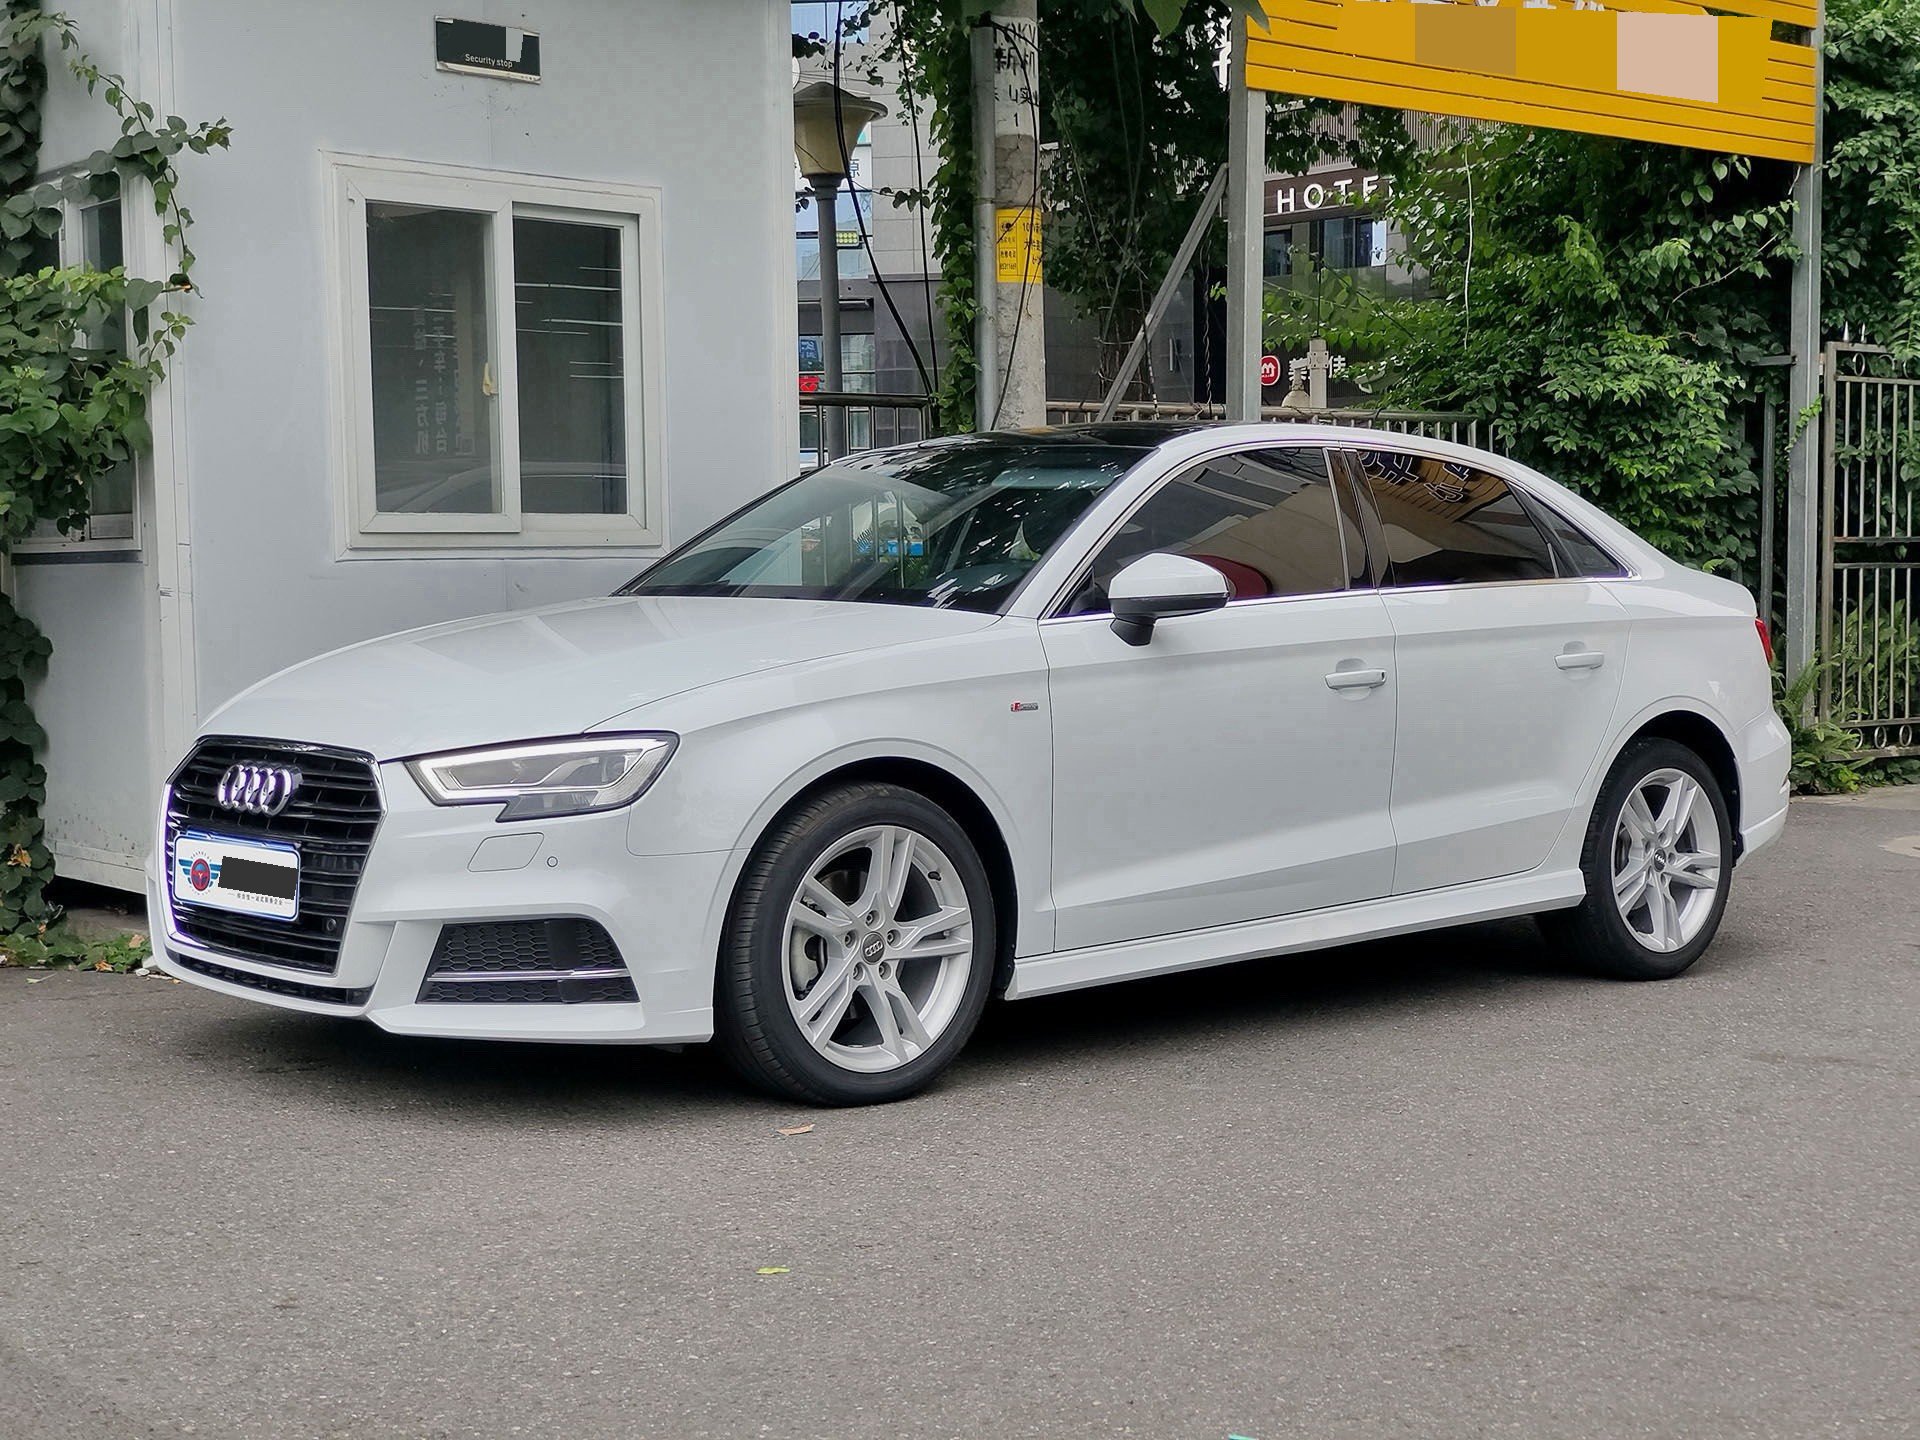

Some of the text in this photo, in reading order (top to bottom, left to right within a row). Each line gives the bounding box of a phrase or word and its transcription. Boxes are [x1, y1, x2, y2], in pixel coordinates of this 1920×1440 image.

[465, 53, 513, 69] Security stop
[1277, 174, 1393, 214] HOTE
